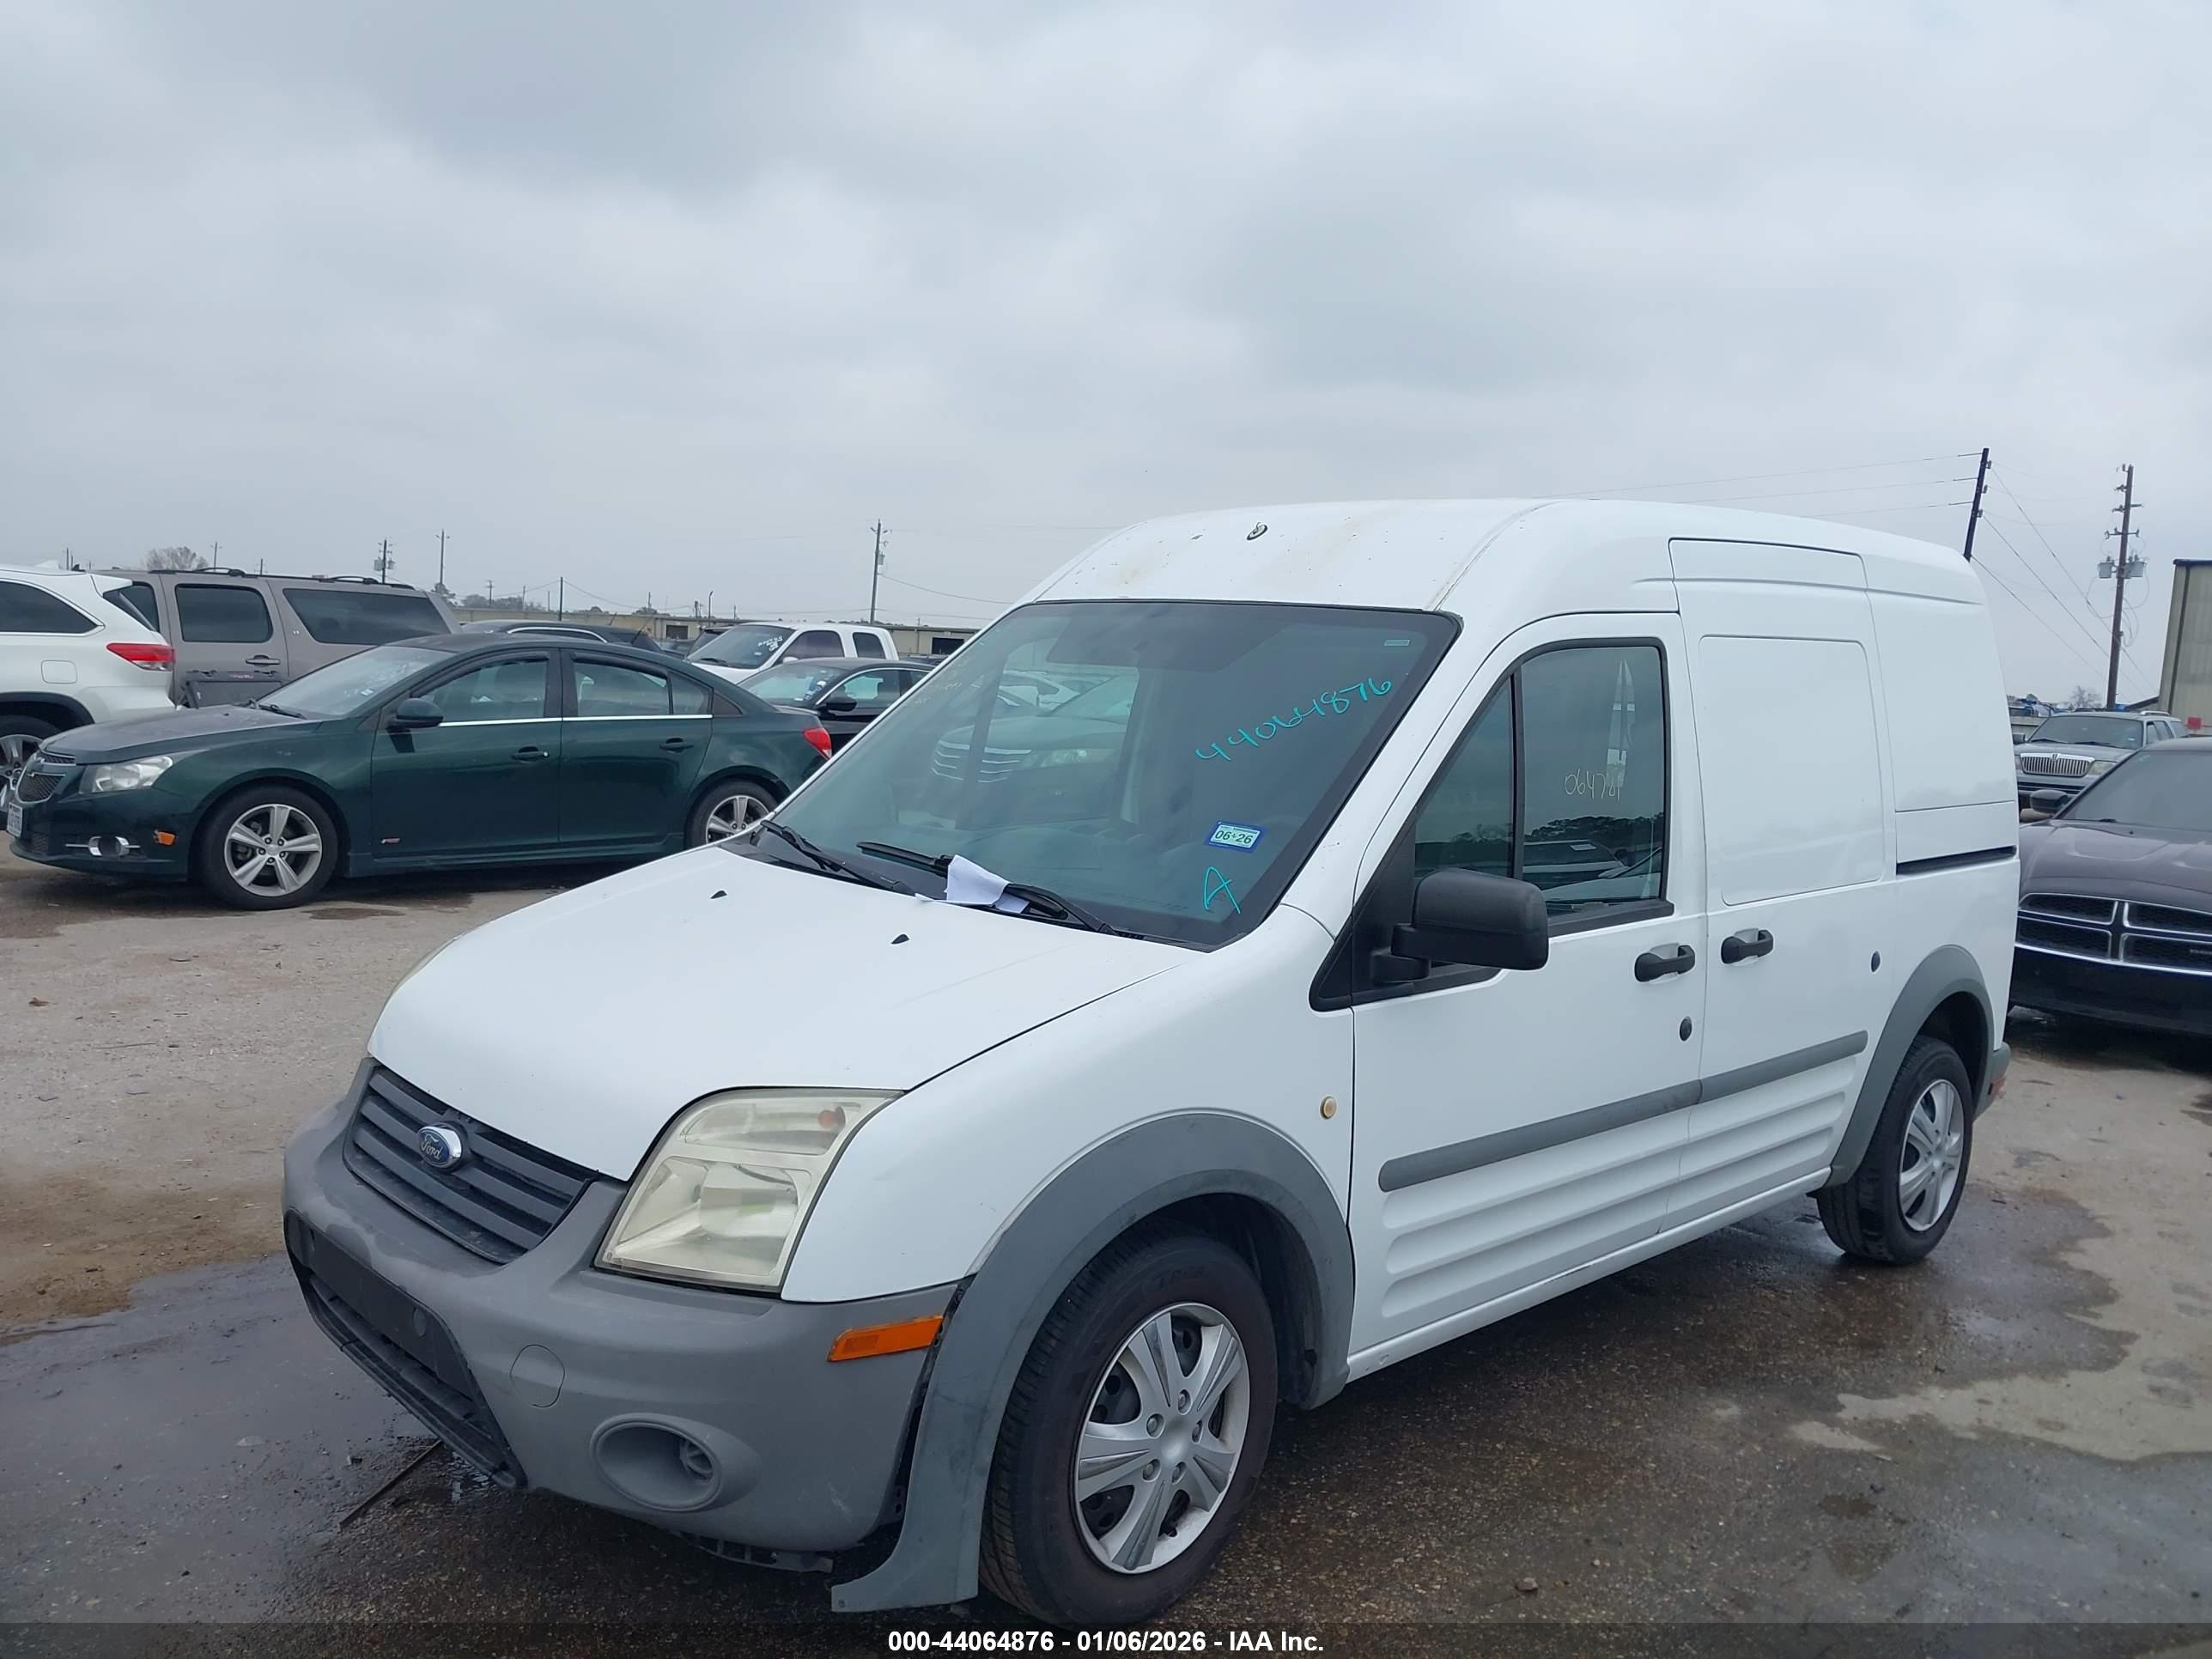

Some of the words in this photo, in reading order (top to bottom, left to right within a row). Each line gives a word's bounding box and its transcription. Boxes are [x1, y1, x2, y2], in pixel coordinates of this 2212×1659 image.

[1194, 678, 1392, 762] 44064876
[1204, 866, 1241, 915] A
[421, 1134, 441, 1160] Ford
